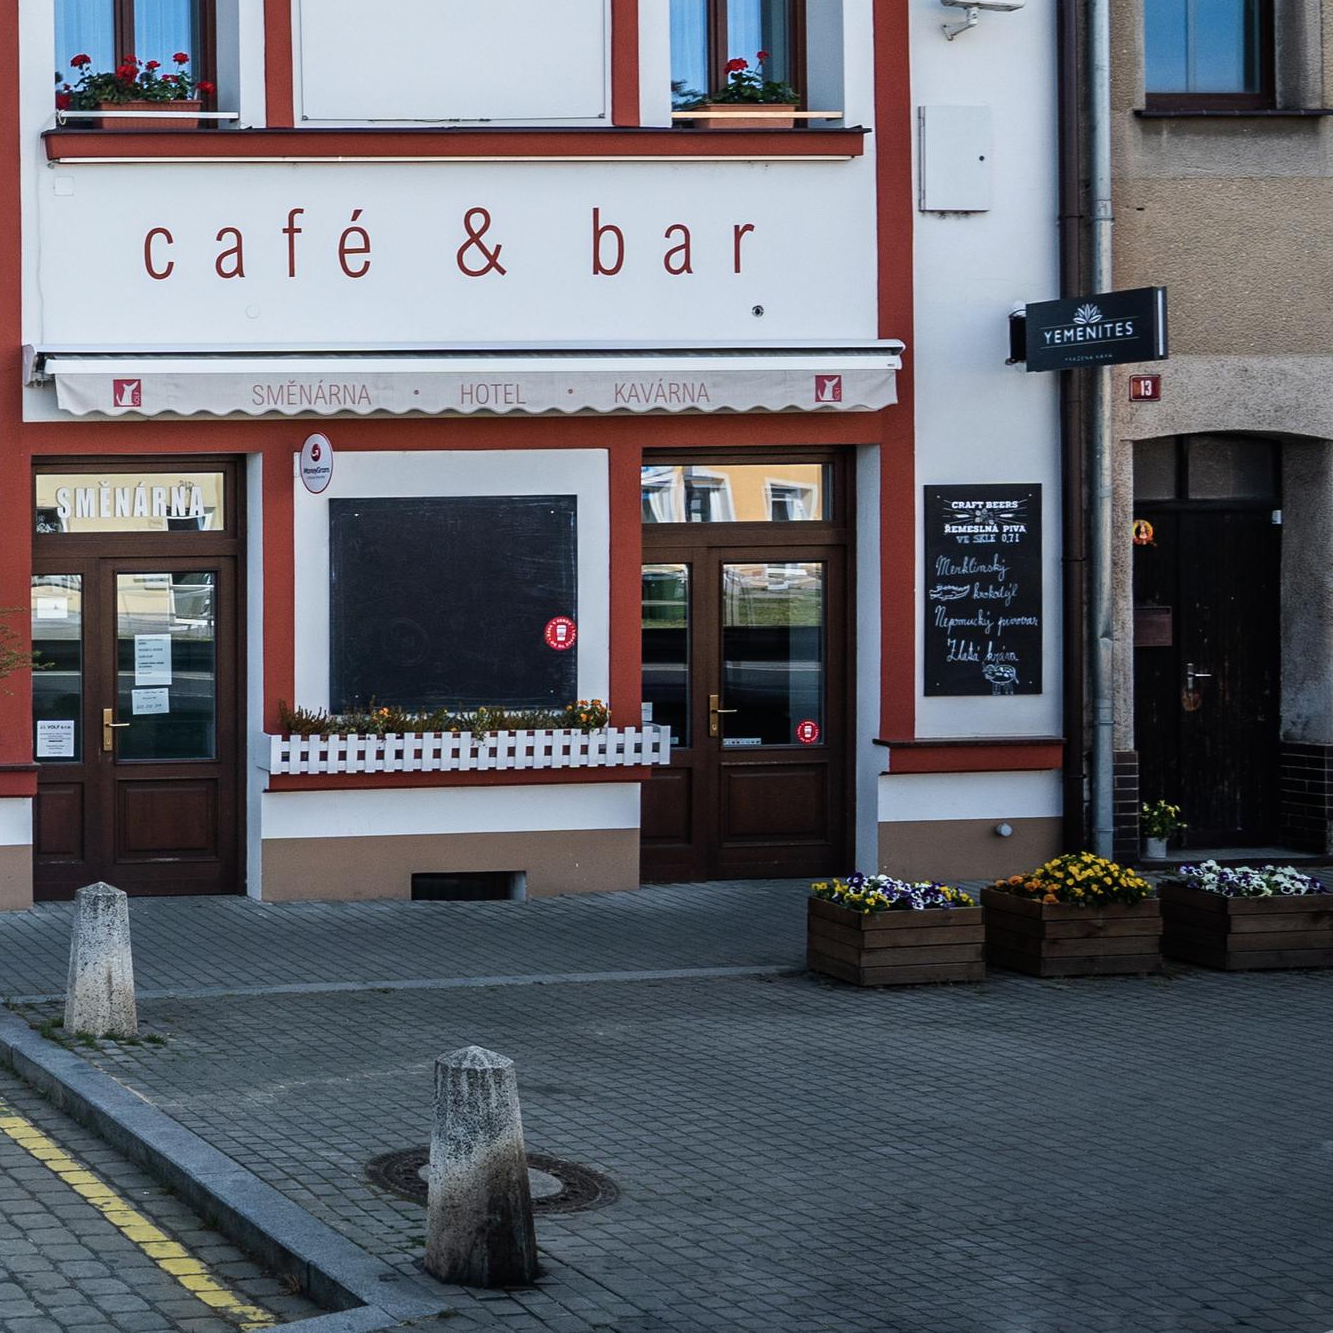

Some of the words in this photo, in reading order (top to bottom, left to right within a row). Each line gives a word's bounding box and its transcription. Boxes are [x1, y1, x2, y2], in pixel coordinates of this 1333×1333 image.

[143, 207, 372, 280] café
[455, 206, 508, 277] &
[592, 206, 756, 277] bar
[1043, 321, 1134, 345] YEMENITES
[252, 379, 372, 406] SMĚNÁRNA
[460, 382, 526, 405] HOTEL
[613, 378, 711, 404] KAVÁRNA
[1140, 379, 1153, 397] 13
[56, 481, 205, 519] SMĚNÁRNA
[951, 500, 984, 509] CRAFT
[986, 500, 1019, 509] BEERS
[944, 523, 999, 534] ŘEMESLNÁ
[1003, 524, 1026, 533] PIVA
[956, 535, 970, 544] VE
